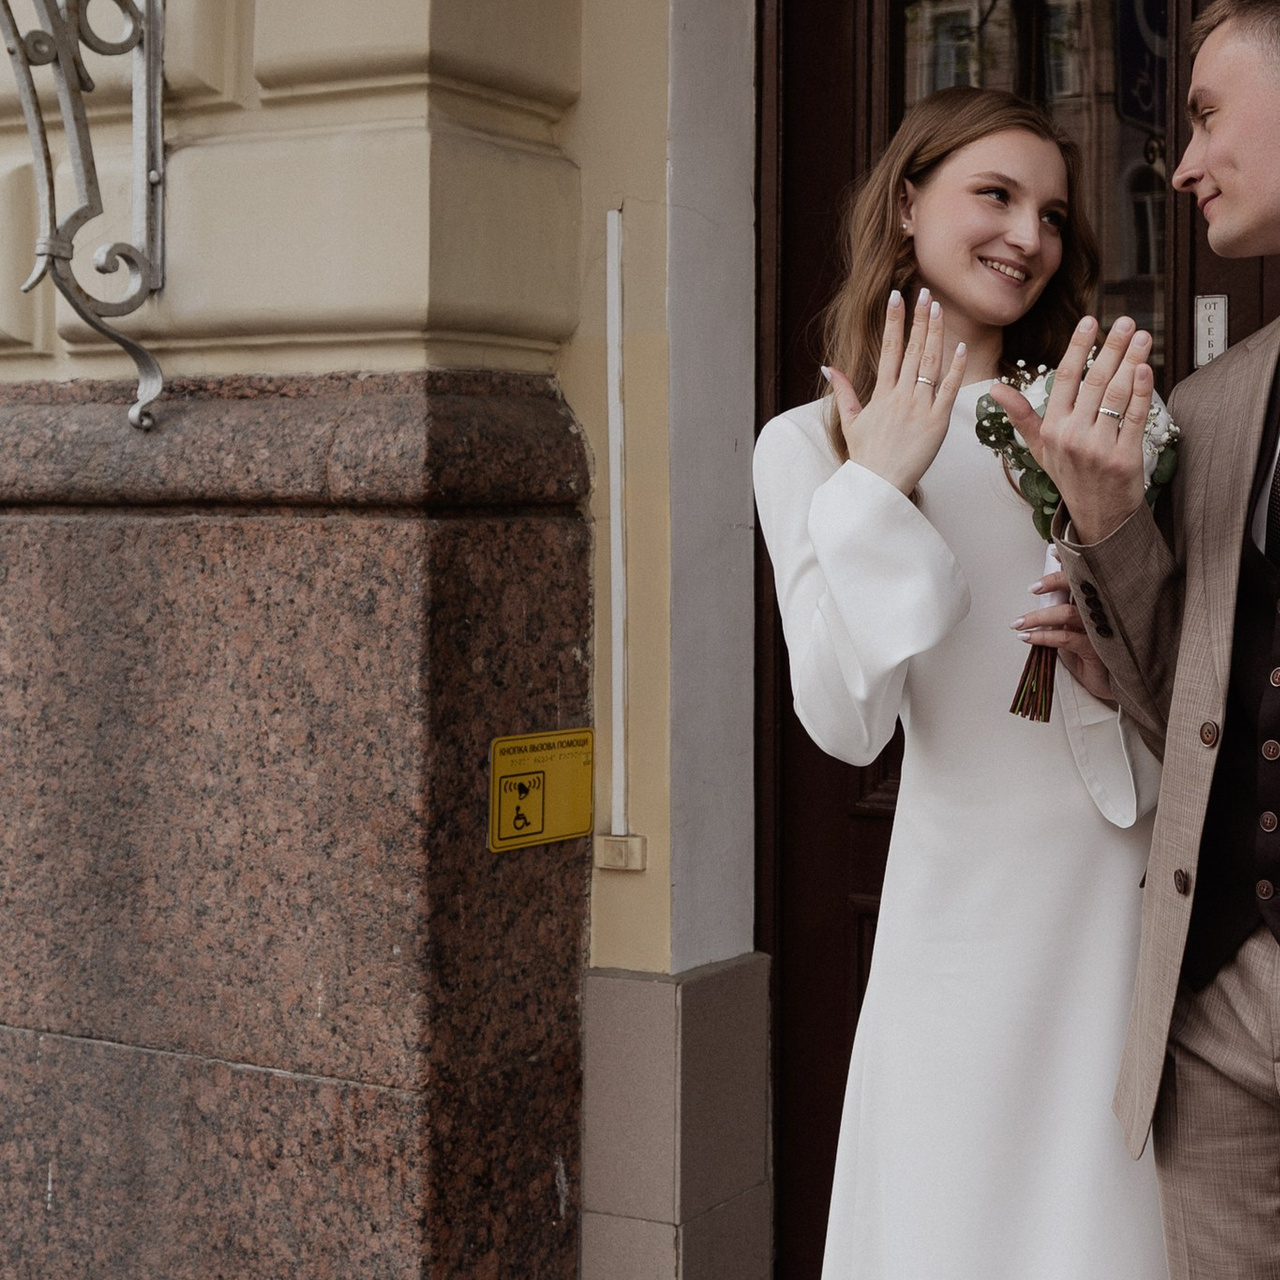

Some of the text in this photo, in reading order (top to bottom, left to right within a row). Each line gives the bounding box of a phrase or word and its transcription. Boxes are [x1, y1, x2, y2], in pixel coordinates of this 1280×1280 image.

[1204, 302, 1218, 310] ОТ
[500, 739, 588, 757] КНОПКА ВЫЗОВА ПОМОЩИ
